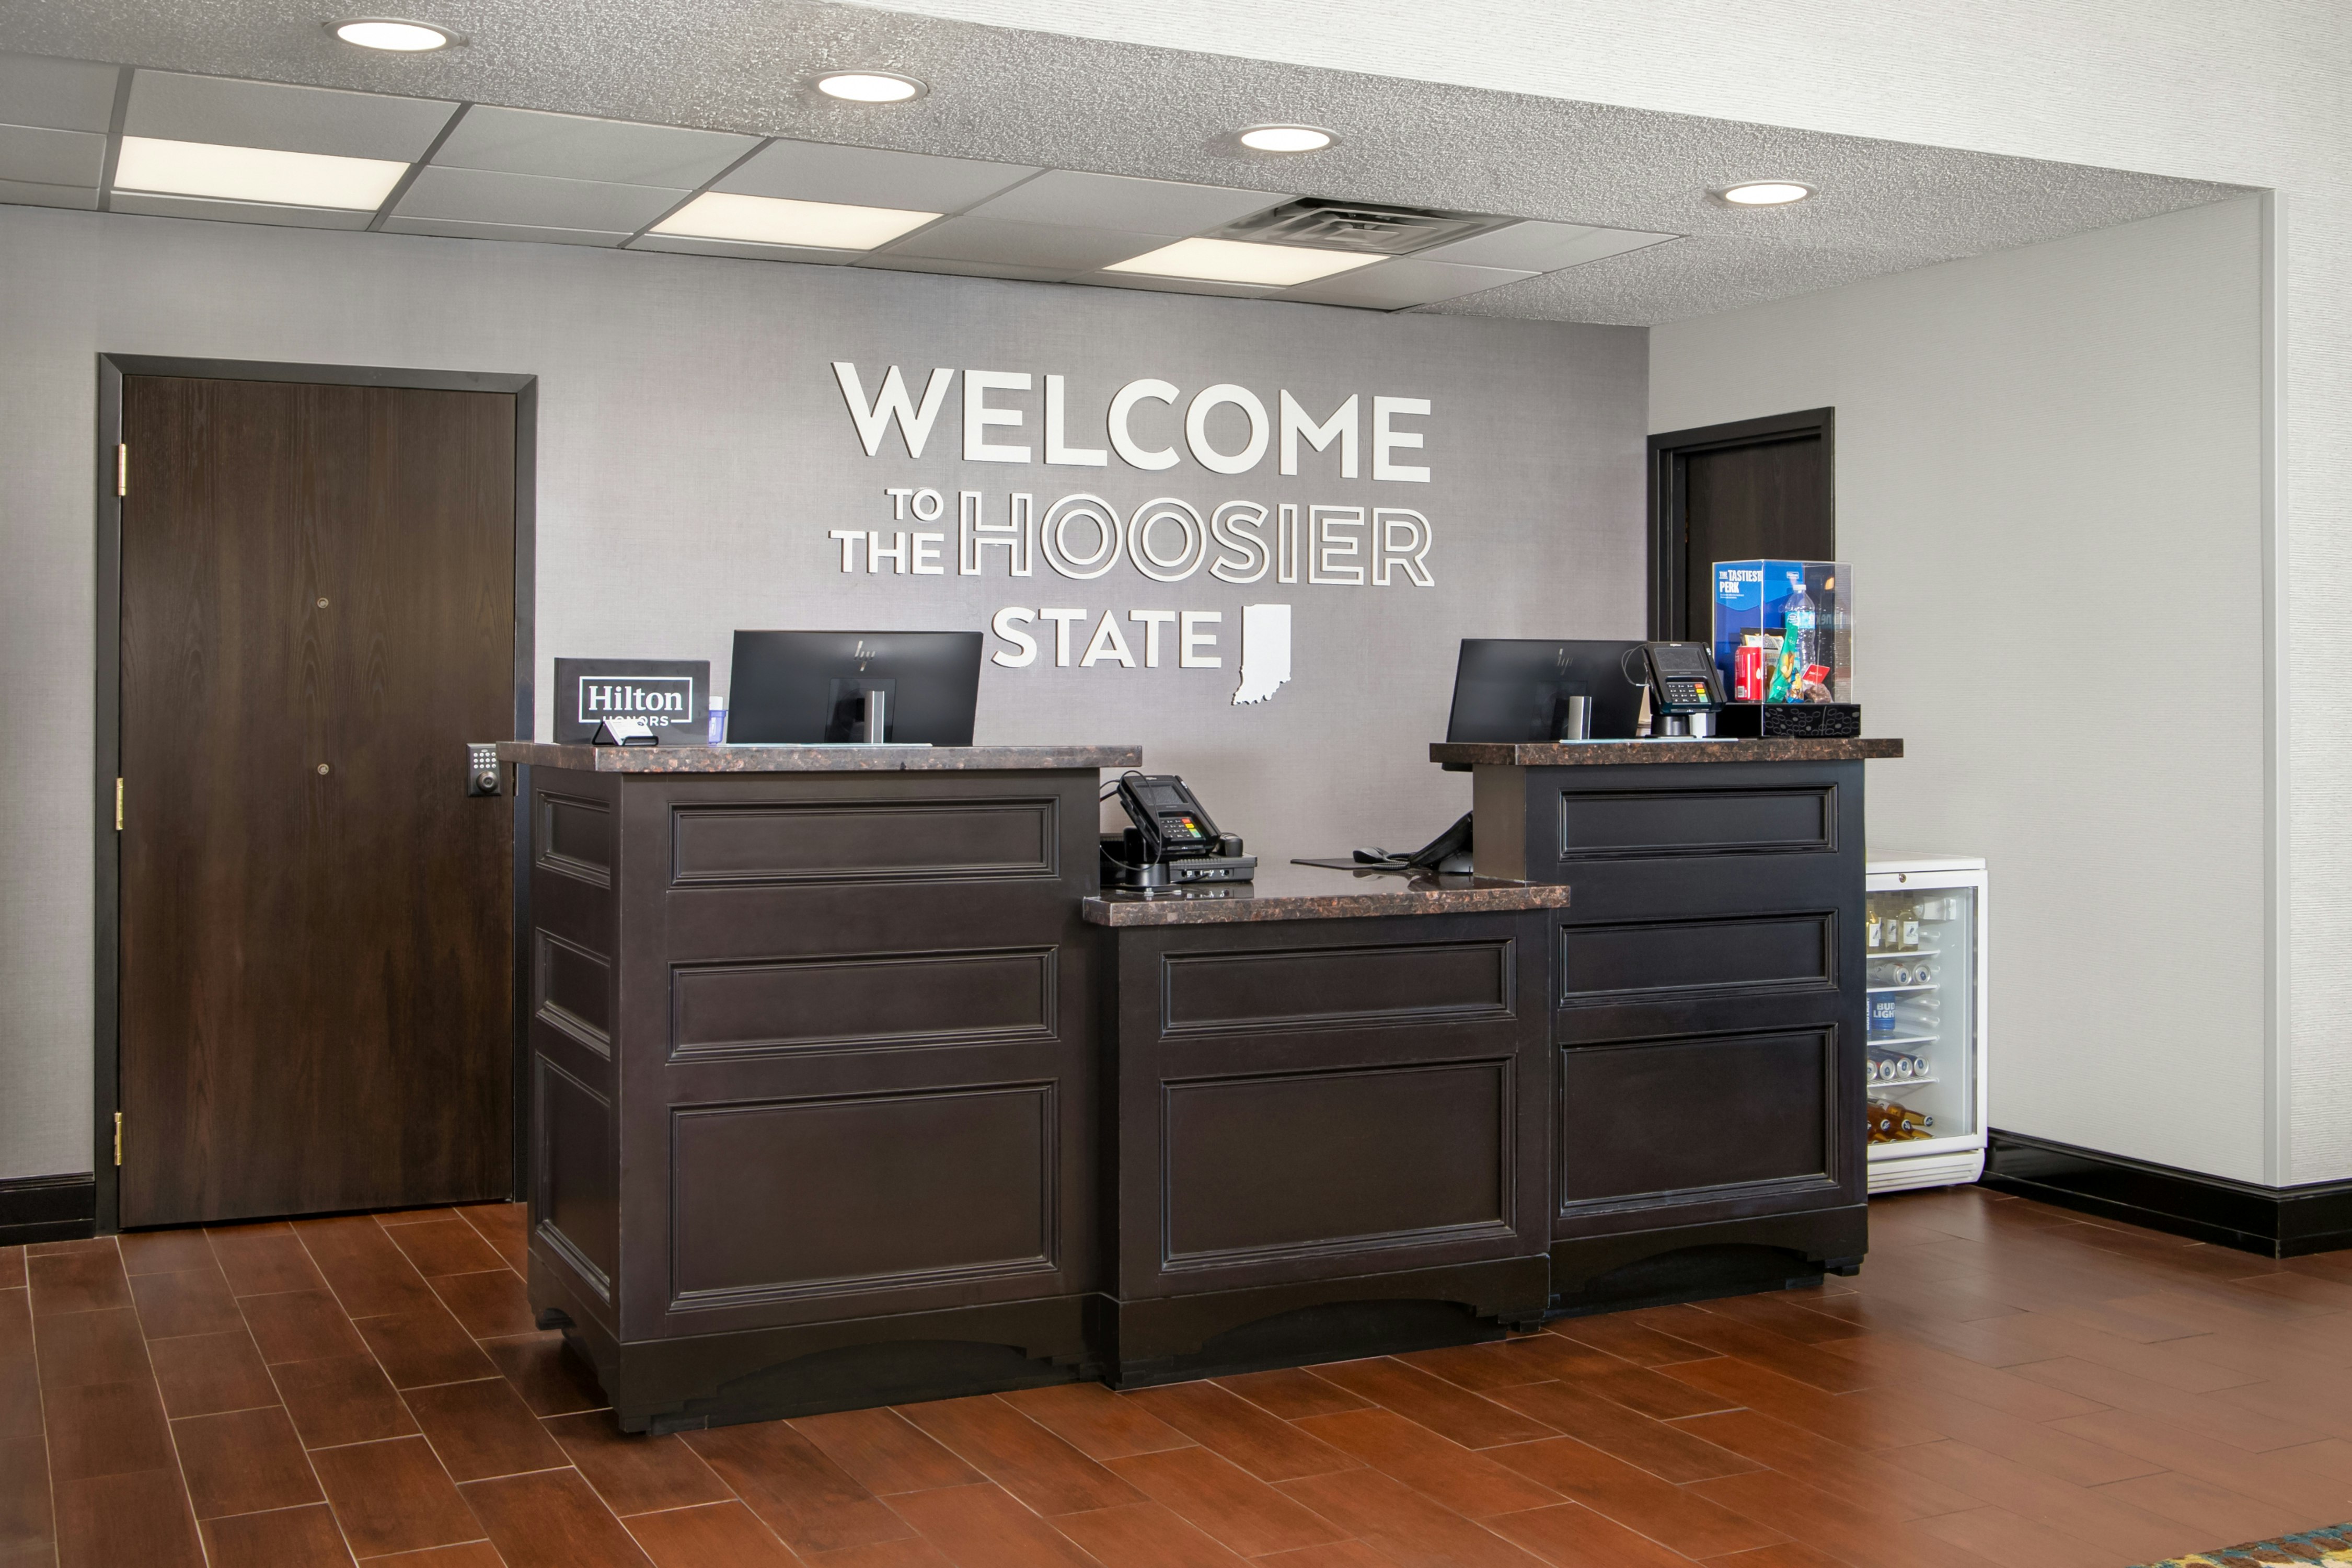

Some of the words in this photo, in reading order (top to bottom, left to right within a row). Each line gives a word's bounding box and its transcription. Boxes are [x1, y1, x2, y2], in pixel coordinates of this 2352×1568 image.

[831, 362, 1431, 482] WELCOME
[884, 488, 944, 521] TO
[828, 530, 944, 574] THE
[958, 491, 1435, 586] HOOSIER
[1720, 581, 1739, 593] PERK
[1728, 570, 1762, 582] TASTIEST
[991, 606, 1222, 668] STATE
[589, 685, 683, 711] Hilton
[1873, 1010, 1895, 1019] LIGH
[1876, 1002, 1895, 1011] BUD
